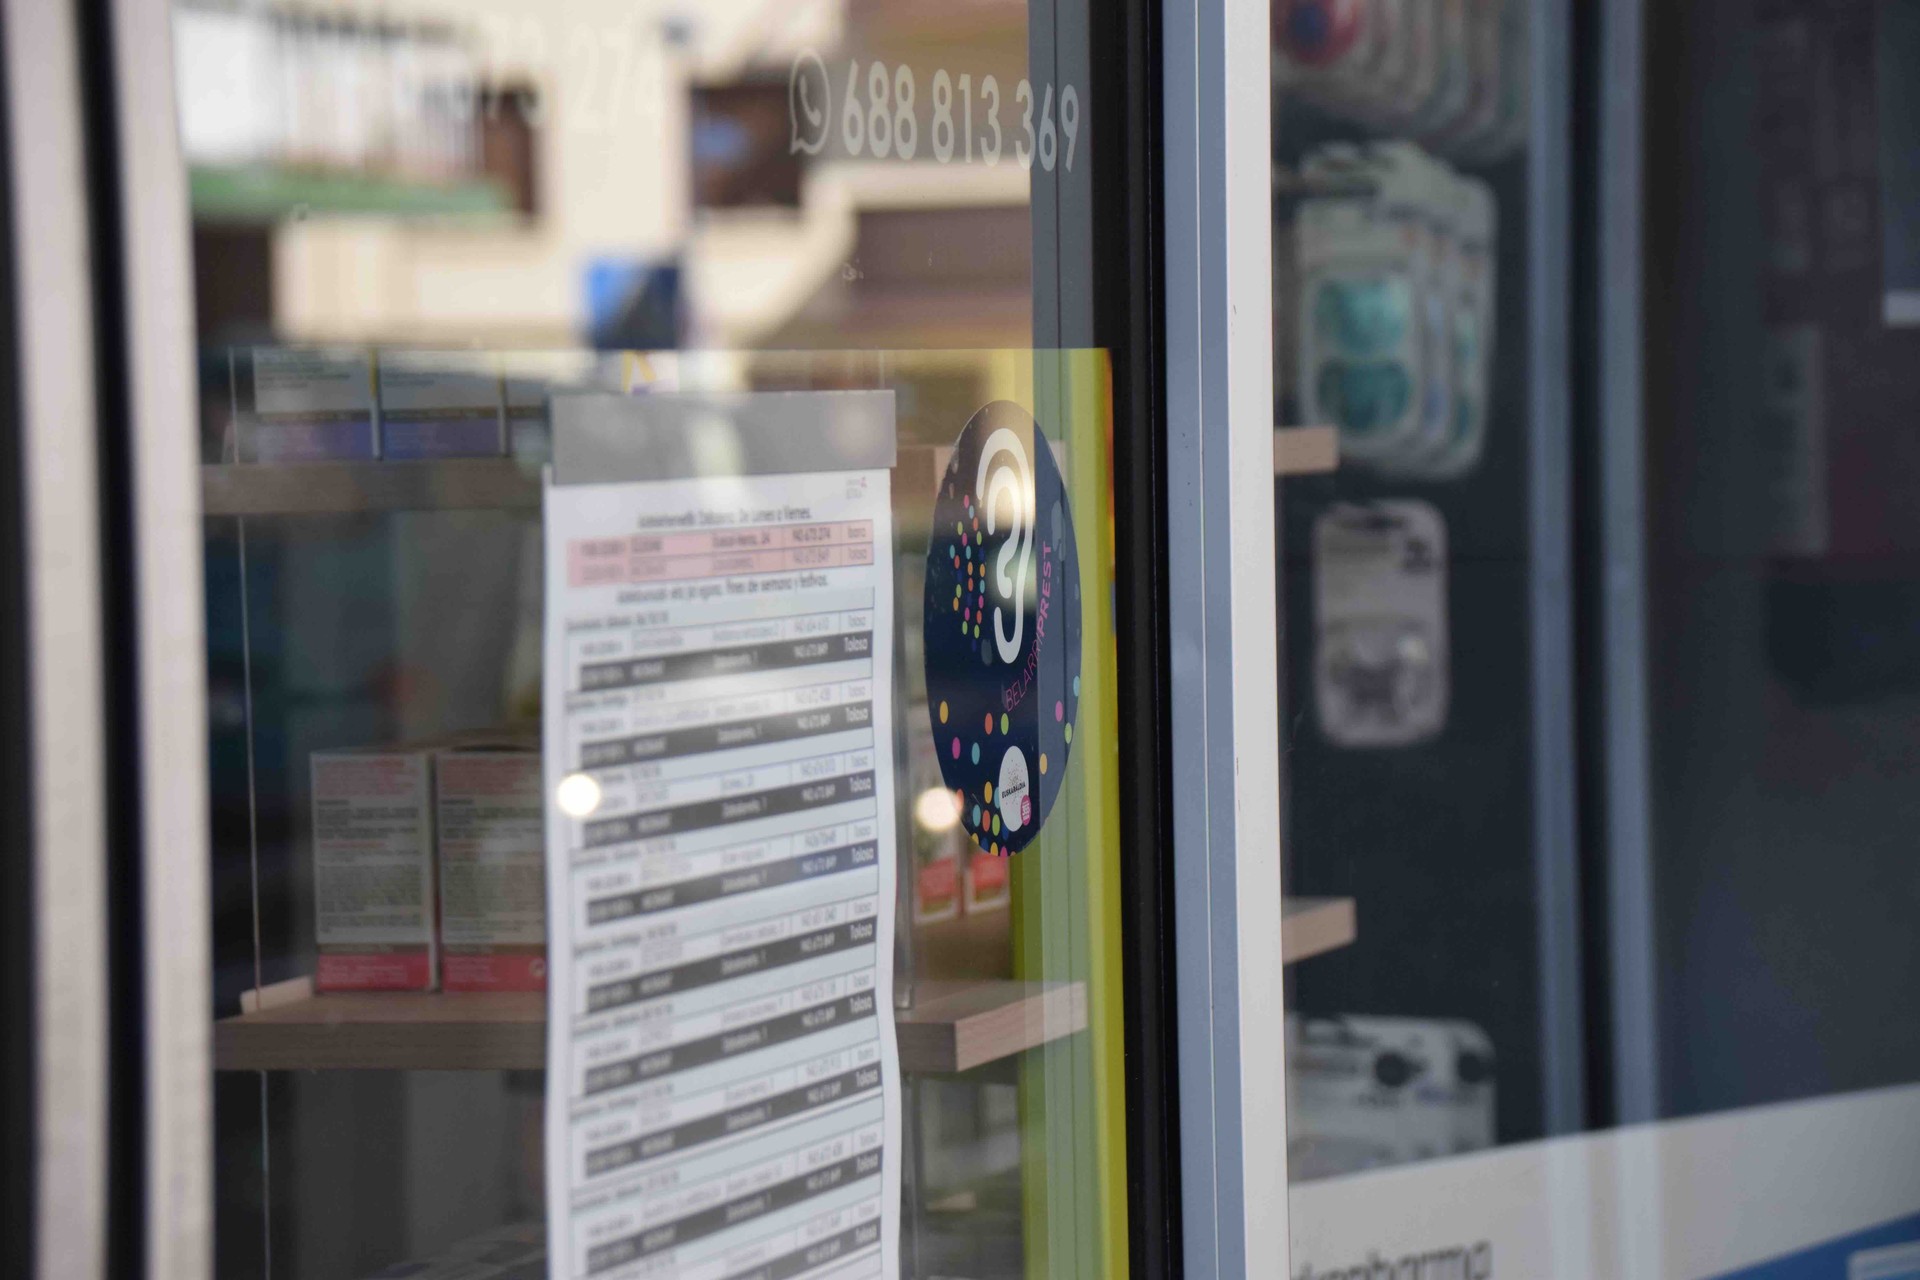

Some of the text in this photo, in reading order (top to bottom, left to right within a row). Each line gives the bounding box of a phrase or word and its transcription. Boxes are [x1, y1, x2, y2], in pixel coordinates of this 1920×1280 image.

[842, 58, 1079, 172] 688 813 369
